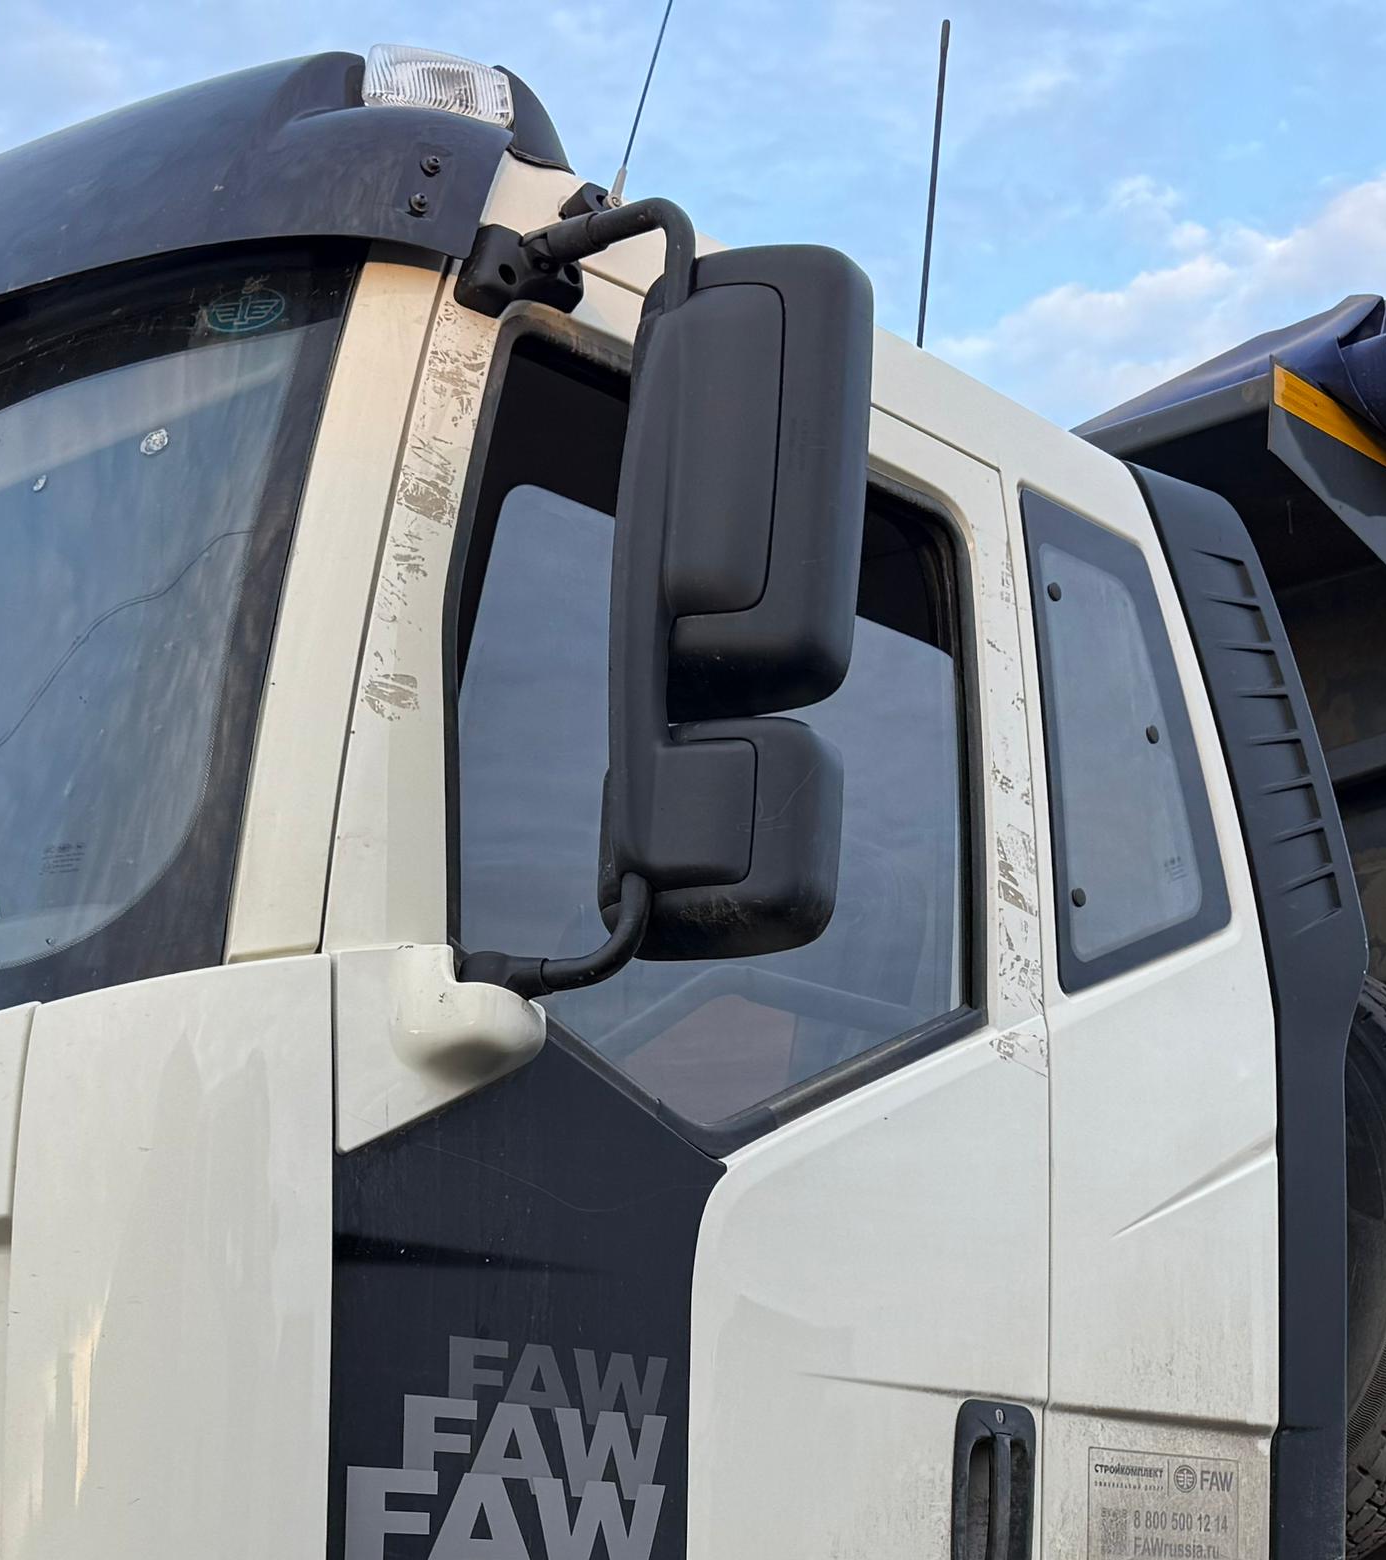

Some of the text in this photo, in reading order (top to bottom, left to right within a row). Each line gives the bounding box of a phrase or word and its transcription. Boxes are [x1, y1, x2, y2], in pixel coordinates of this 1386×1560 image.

[448, 1335, 668, 1429] FAW
[403, 1394, 667, 1500] FAW
[1200, 1470, 1233, 1492] FAW
[1134, 1510, 1228, 1533] 8 800 500 12 14
[1133, 1537, 1220, 1559] FAWrussia.ru
